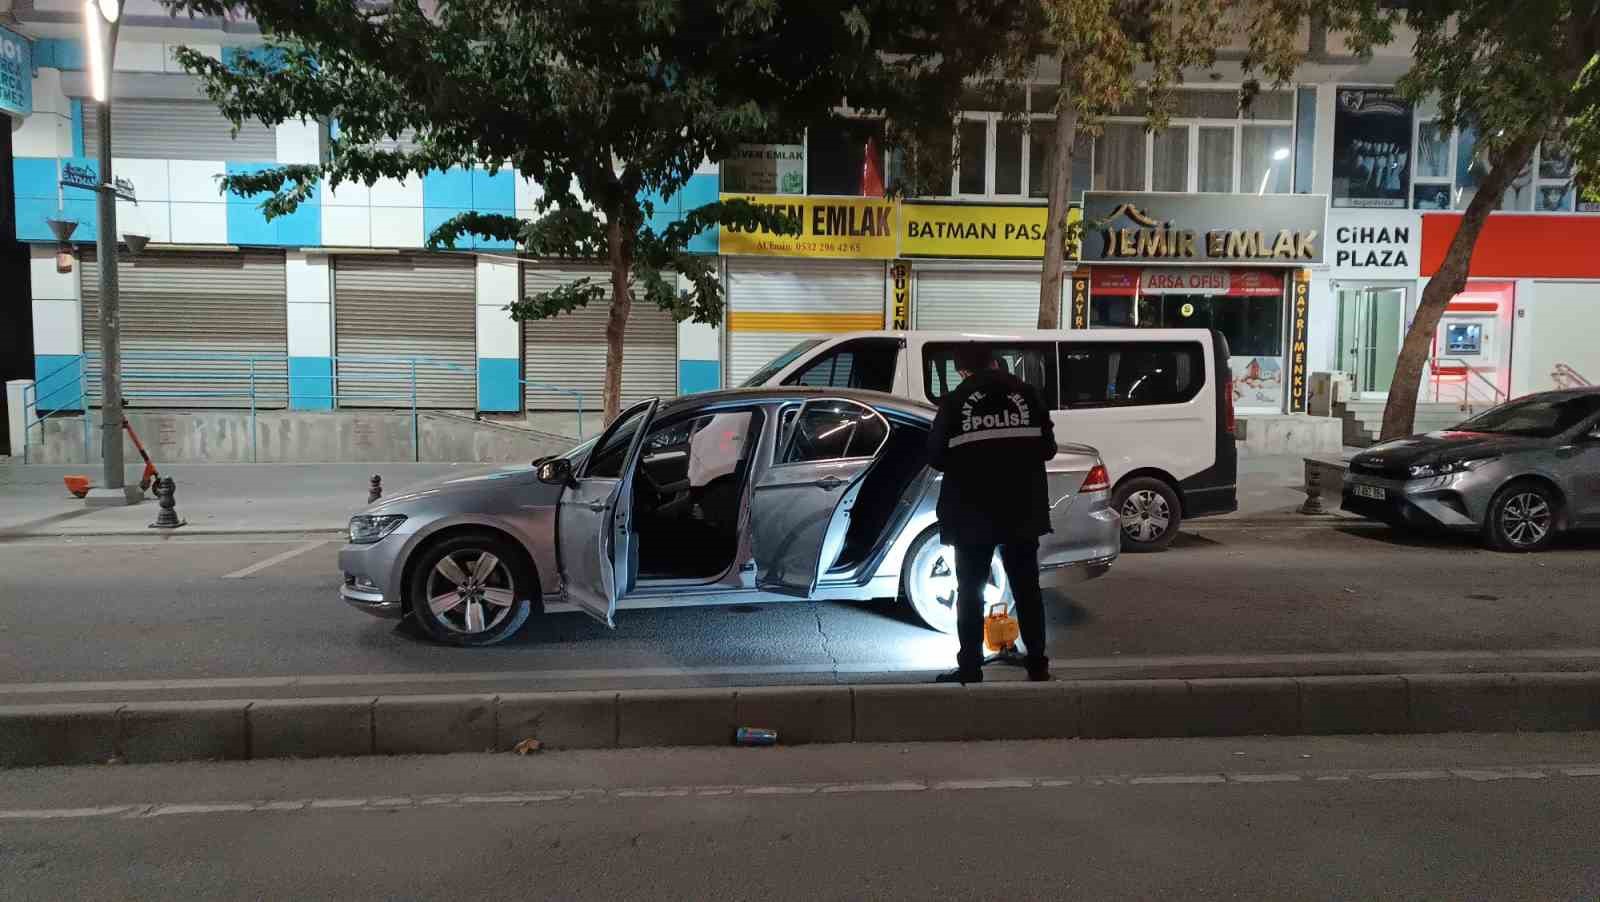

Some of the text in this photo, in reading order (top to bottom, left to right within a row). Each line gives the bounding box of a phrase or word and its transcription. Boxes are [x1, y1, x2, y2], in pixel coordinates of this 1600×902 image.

[812, 204, 893, 237] EMLAK
[908, 220, 996, 240] BATMAN
[1205, 228, 1318, 258] EMLAK
[1336, 250, 1409, 267] PLAZA
[1148, 273, 1184, 289] ARSA
